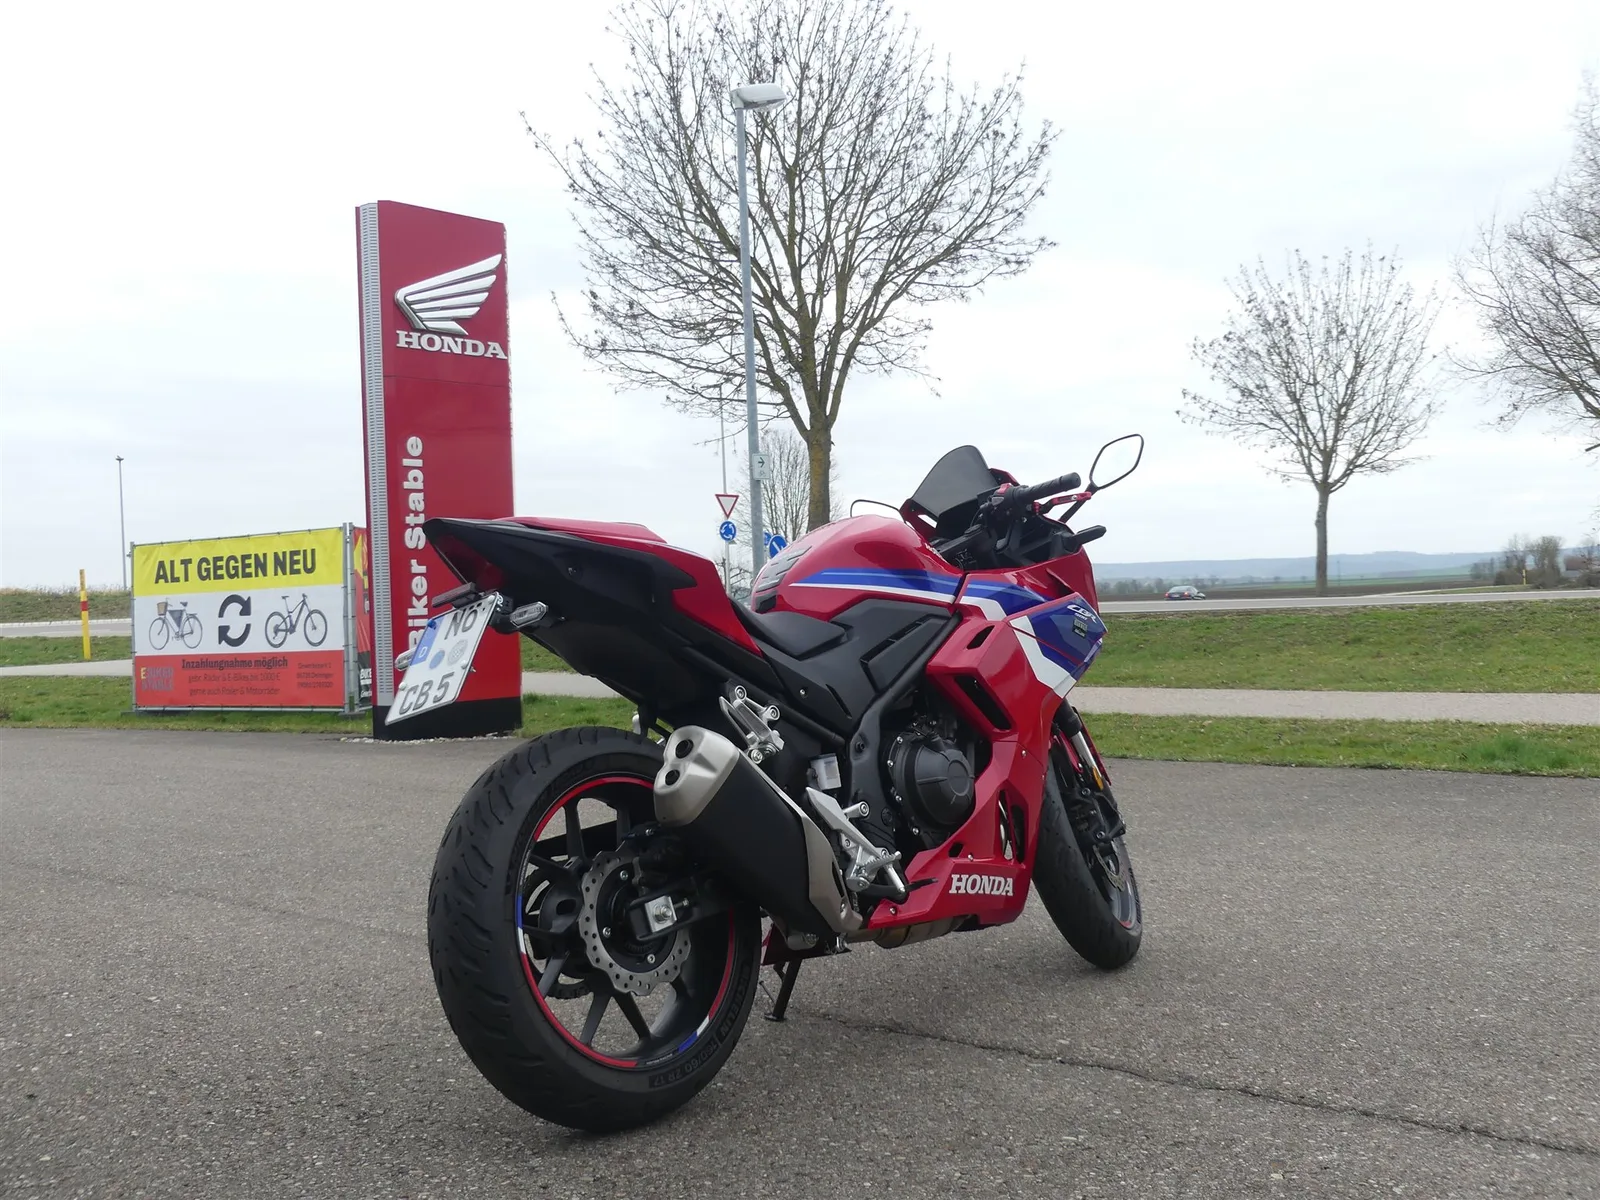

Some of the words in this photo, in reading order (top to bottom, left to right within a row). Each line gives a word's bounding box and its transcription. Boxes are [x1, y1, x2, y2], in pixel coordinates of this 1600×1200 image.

[396, 330, 508, 359] HONDA
[402, 436, 426, 550] Stable
[155, 558, 192, 584] ALT
[197, 553, 267, 581] GEGEN
[274, 548, 316, 576] NEU
[182, 658, 253, 670] Inzahlungnahme
[254, 656, 288, 669] möglich
[419, 646, 428, 658] D
[399, 680, 433, 715] CB
[433, 672, 455, 704] 5
[949, 874, 1013, 896] HONDA
